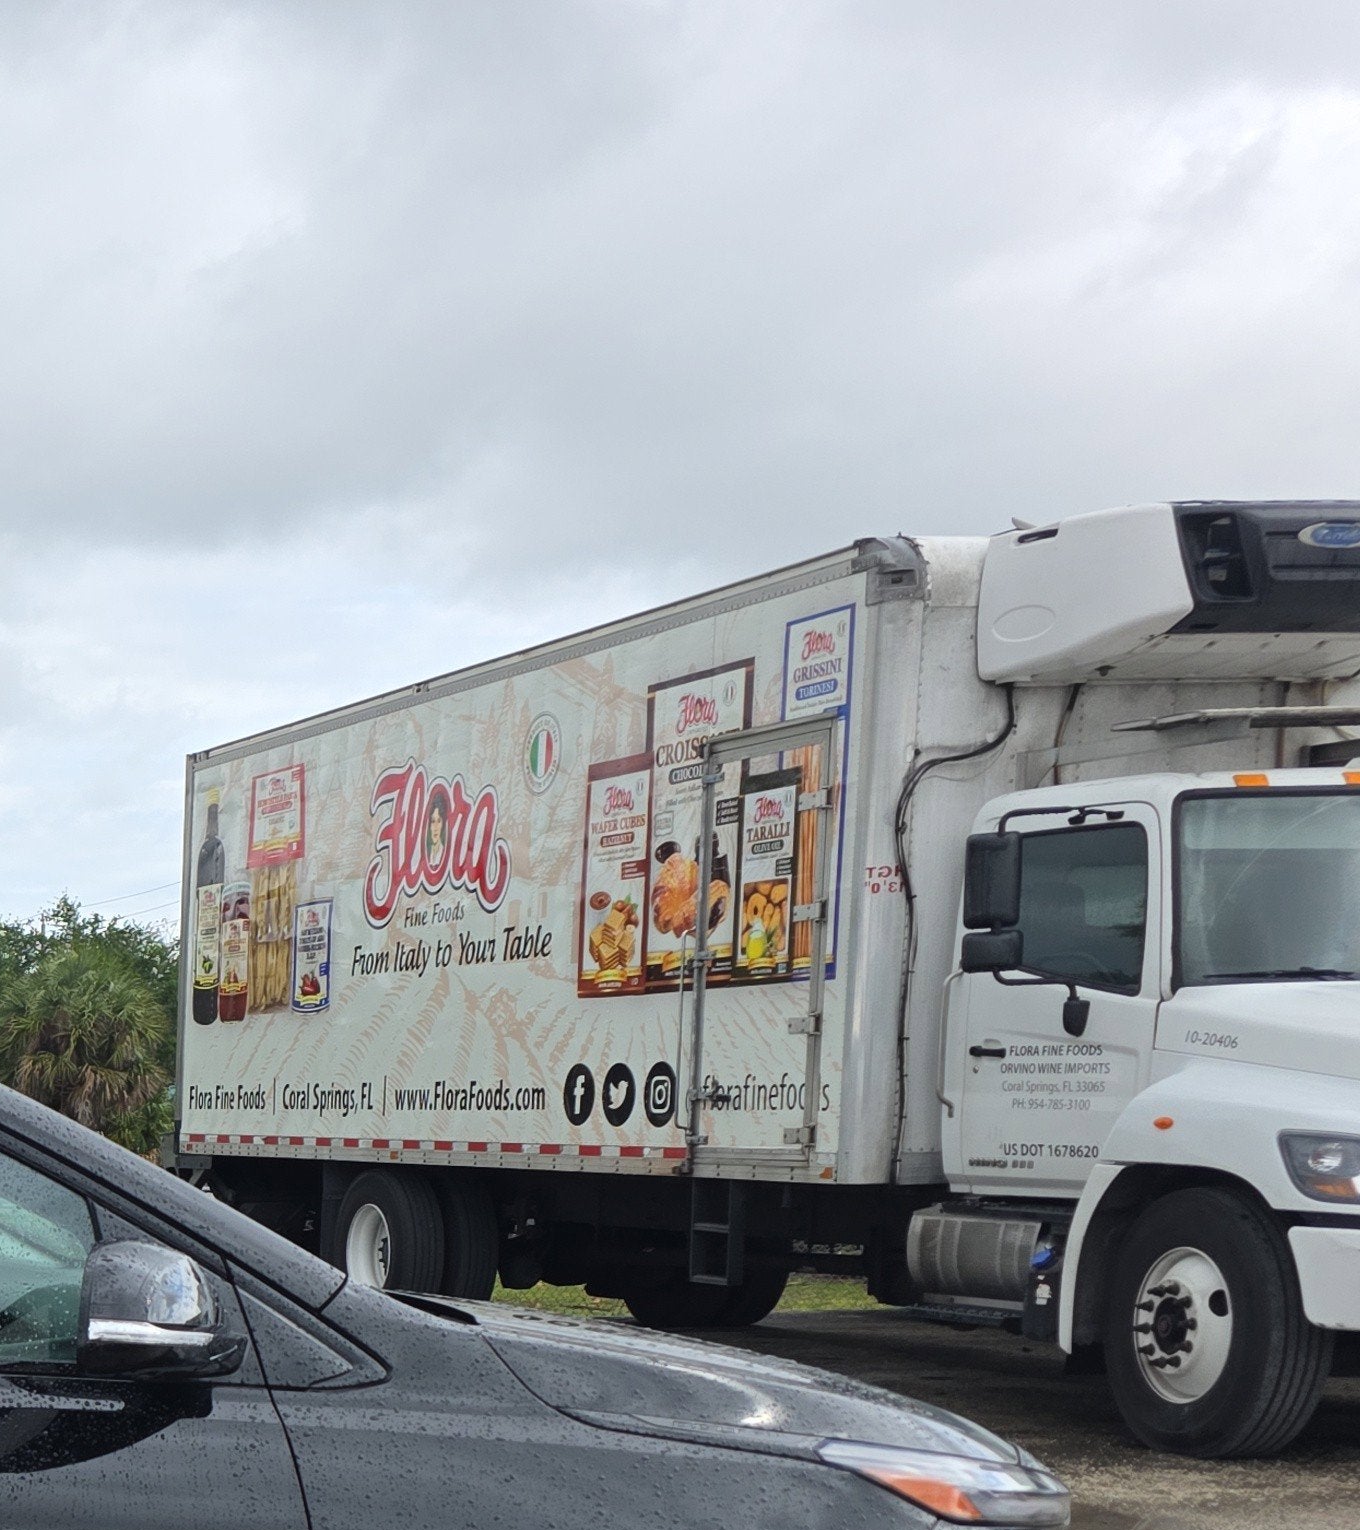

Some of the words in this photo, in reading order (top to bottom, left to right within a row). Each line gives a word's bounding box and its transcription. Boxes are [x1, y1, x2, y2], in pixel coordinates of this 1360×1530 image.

[793, 658, 842, 683] GRISSINI
[799, 680, 835, 699] TORINESI
[675, 692, 718, 736] Flora
[656, 727, 741, 767] CROIS
[672, 762, 721, 782] CHOCOL
[591, 819, 618, 834] WAFER
[620, 813, 646, 831] CUBES
[746, 821, 791, 843] TARALLI
[364, 758, 511, 928] Flora
[404, 905, 428, 928] Fine
[431, 901, 465, 925] Foods
[351, 945, 389, 977] From
[393, 940, 431, 978] Italy
[435, 939, 452, 967] to
[458, 931, 496, 966] Your
[502, 925, 553, 962] Table
[1009, 1045, 1040, 1057] FLORA
[1042, 1045, 1065, 1056] FINE
[1066, 1045, 1103, 1056] FOODS
[1184, 1030, 1239, 1049] 10-20406
[1000, 1063, 1036, 1074] ORVINO
[1037, 1063, 1062, 1074] WINE
[1064, 1063, 1111, 1074] IMPORTS
[189, 1084, 213, 1110] Flora
[214, 1084, 235, 1110] Fine
[237, 1084, 266, 1110] Foods
[395, 1080, 546, 1111] www.FloraFoods.com
[1002, 1081, 1024, 1092] Coral
[1062, 1081, 1073, 1092] FL
[1075, 1081, 1105, 1093] 33065
[282, 1083, 310, 1110] Coral
[312, 1083, 359, 1117] Springs,
[361, 1082, 374, 1110] FL
[1003, 1143, 1018, 1156] US
[1020, 1143, 1045, 1156] DOT
[1047, 1144, 1099, 1158] 1678620
